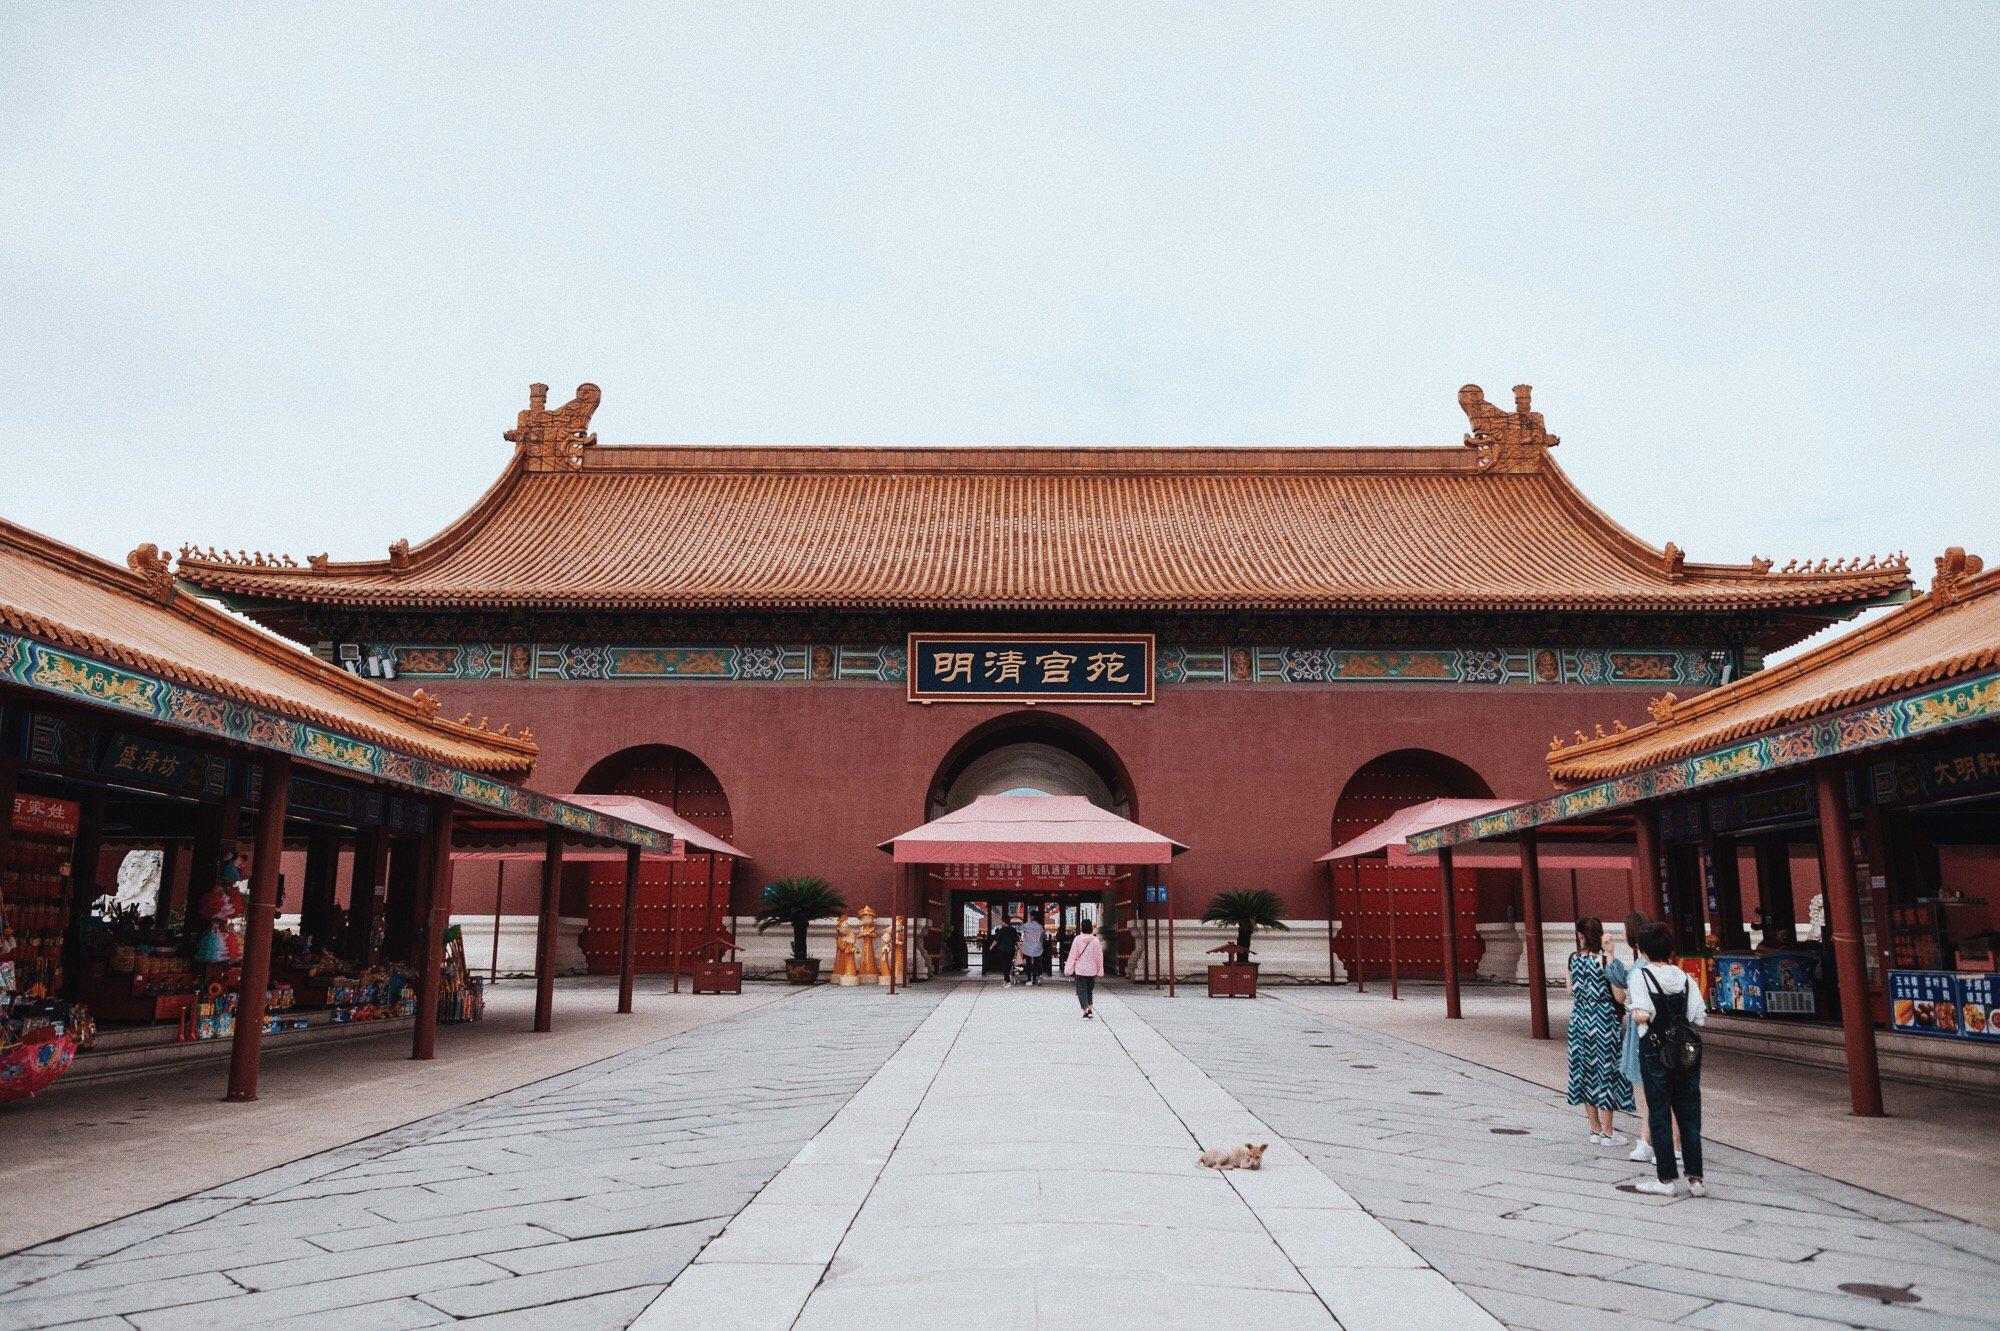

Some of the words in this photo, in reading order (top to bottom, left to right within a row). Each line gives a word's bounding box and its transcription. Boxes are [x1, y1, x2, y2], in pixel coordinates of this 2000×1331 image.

[933, 650, 1130, 685] 明清宫苑
[114, 744, 180, 777] 盛清坊
[1032, 864, 1071, 875] 团队通道
[1077, 864, 1116, 875] 团队通道
